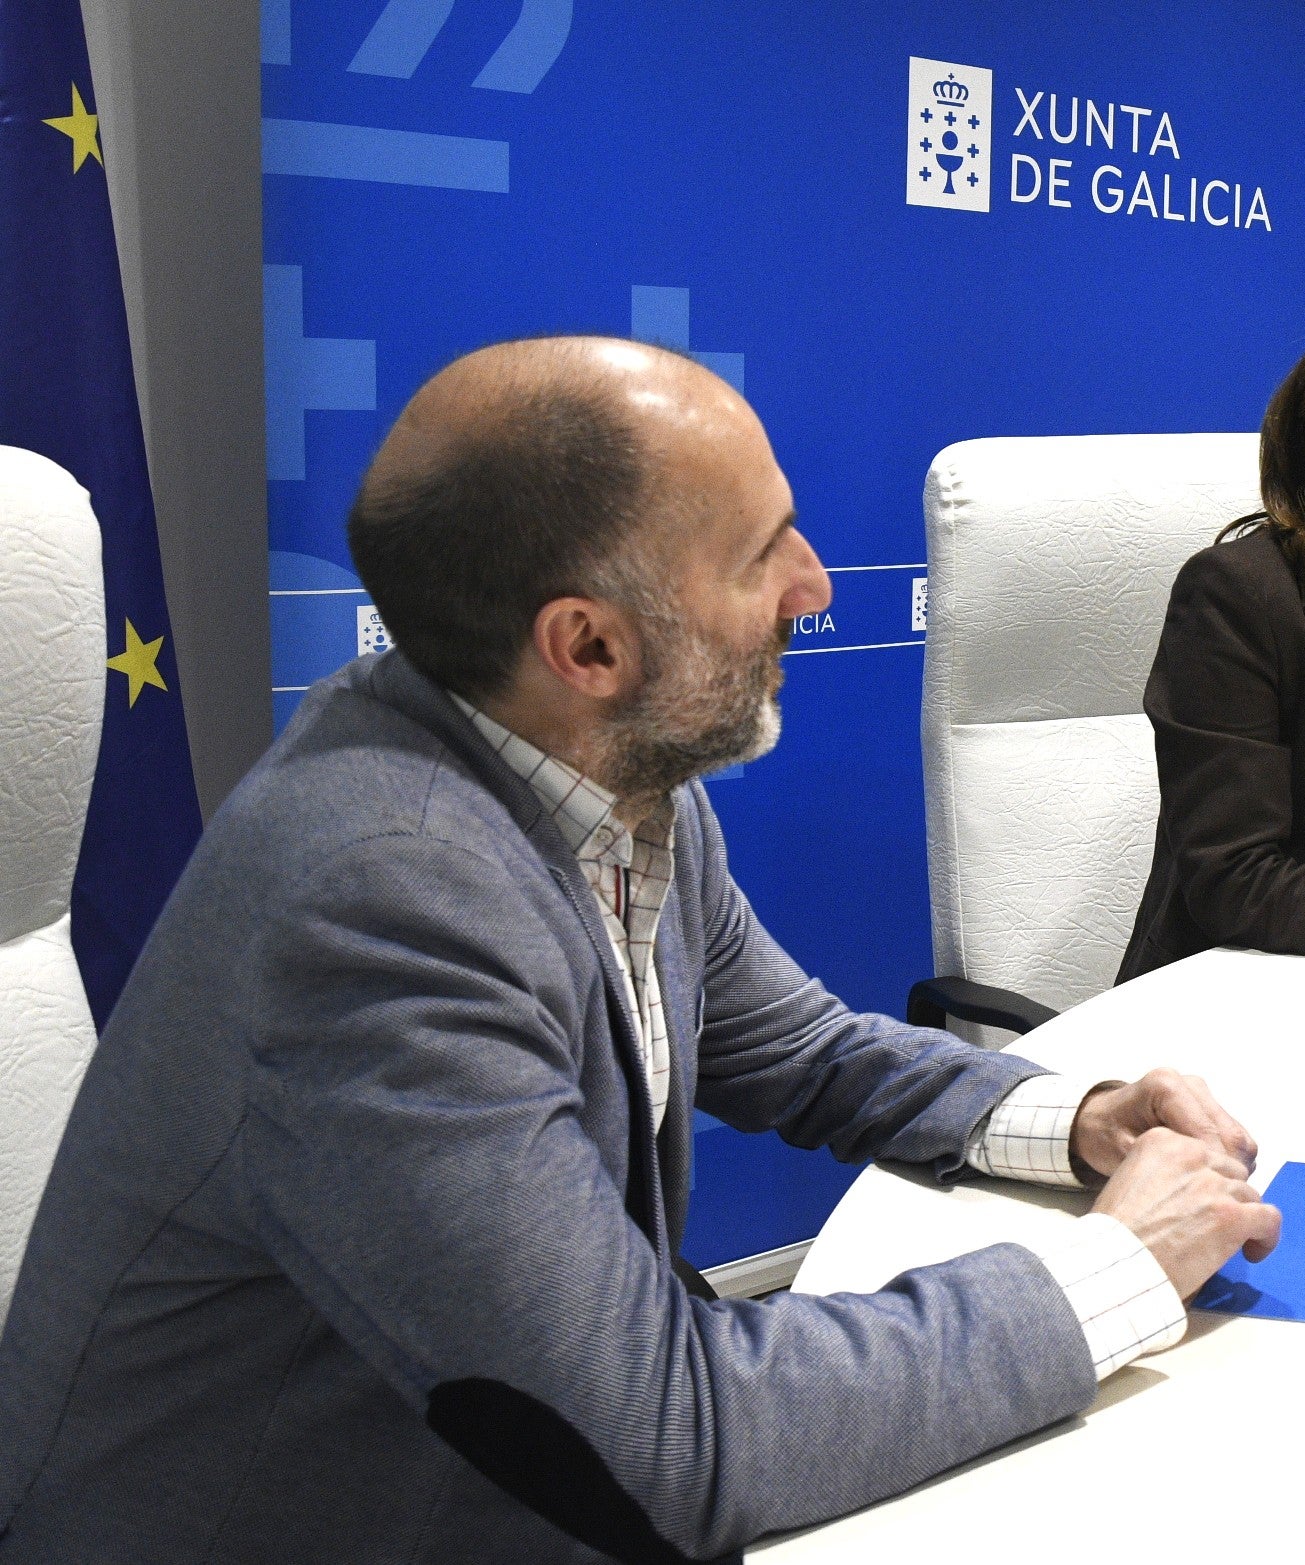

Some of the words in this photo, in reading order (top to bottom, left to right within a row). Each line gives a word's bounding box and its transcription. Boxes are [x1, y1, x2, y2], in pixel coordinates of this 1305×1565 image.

[1012, 87, 1181, 159] XUNTA
[1010, 153, 1073, 208] DE
[1091, 164, 1272, 232] GALICIA
[788, 613, 836, 635] ICIA
